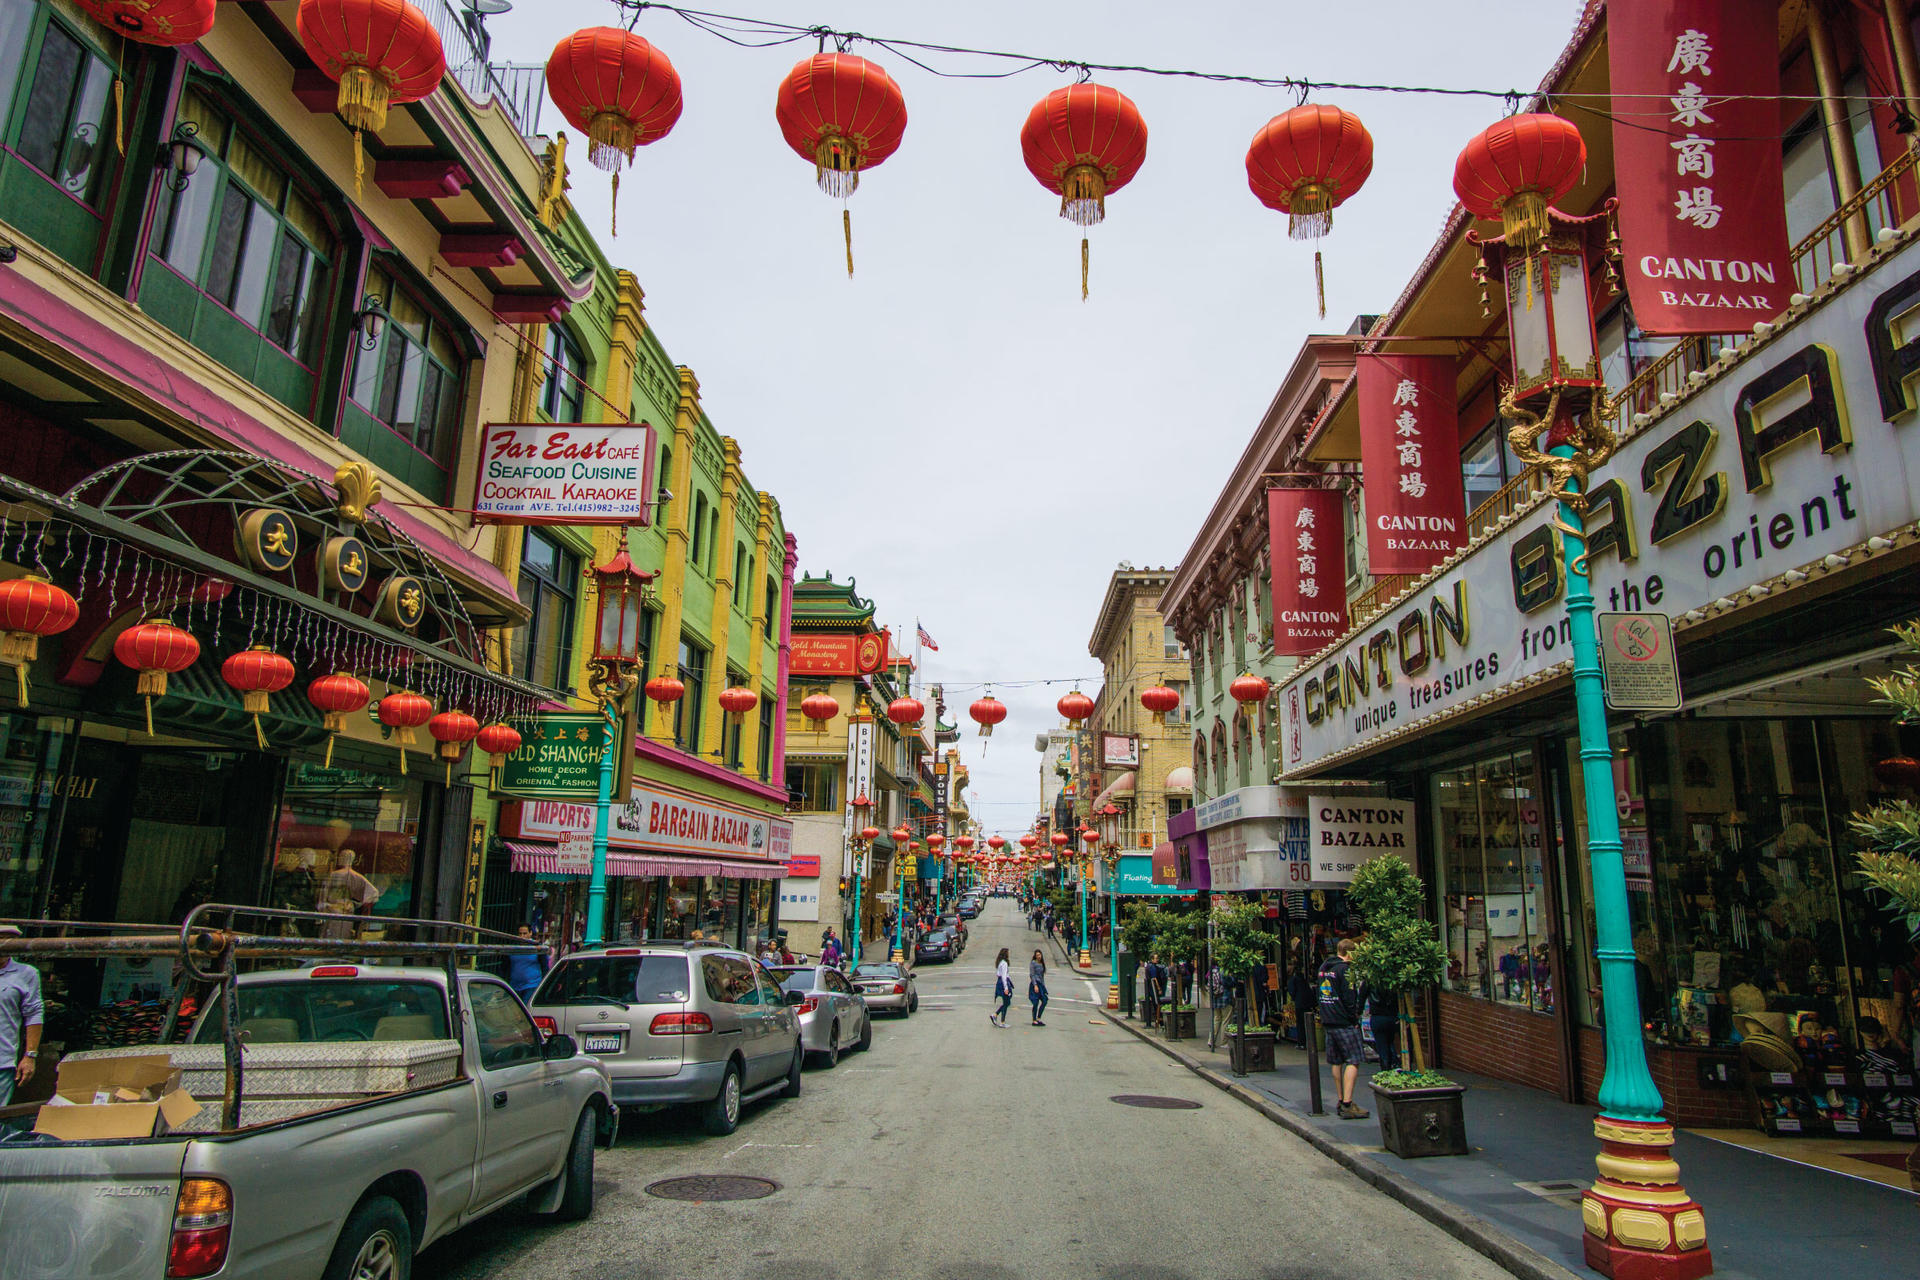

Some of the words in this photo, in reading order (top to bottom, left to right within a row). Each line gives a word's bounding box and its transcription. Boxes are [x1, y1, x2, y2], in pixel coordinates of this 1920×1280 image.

[1666, 28, 1723, 230] 廣東商場
[1640, 255, 1776, 284] CANTON
[1658, 290, 1773, 310] BAZAAR
[490, 430, 539, 460] Far
[542, 432, 609, 460] East
[607, 444, 640, 460] CAFÉ
[1392, 379, 1428, 499] 廣東商場
[488, 461, 566, 479] SEAFOOD
[572, 462, 637, 480] CUISINE
[483, 481, 557, 500] COCKTAIL
[562, 483, 637, 501] KARAOKE
[477, 502, 492, 511] 631
[496, 503, 525, 511] Grant
[529, 503, 554, 511] AVE.
[1376, 514, 1456, 533] CANTON
[1295, 507, 1321, 599] 廣東商場
[1386, 538, 1451, 551] BAZAAR
[1354, 699, 1398, 733] unique
[1409, 651, 1499, 710] treasures
[1609, 573, 1664, 612] the
[1703, 474, 1857, 580] orient
[1281, 610, 1341, 624] CANTON
[1287, 628, 1336, 638] BAZAAR
[797, 650, 838, 660] Monastery
[810, 641, 847, 650] Mountain
[1304, 579, 1469, 728] CANTON
[516, 778, 557, 786] ORIENTAL
[533, 801, 591, 829] IMPORTS
[648, 801, 709, 841] BARGAIN
[711, 815, 749, 847] BAZAAR
[1320, 807, 1404, 825] CANTON
[560, 832, 570, 842] NO
[1320, 831, 1406, 847] BAZAAR
[1320, 863, 1333, 871] WE
[1336, 863, 1356, 872] SHIP
[95, 1184, 171, 1198] TACOMA
